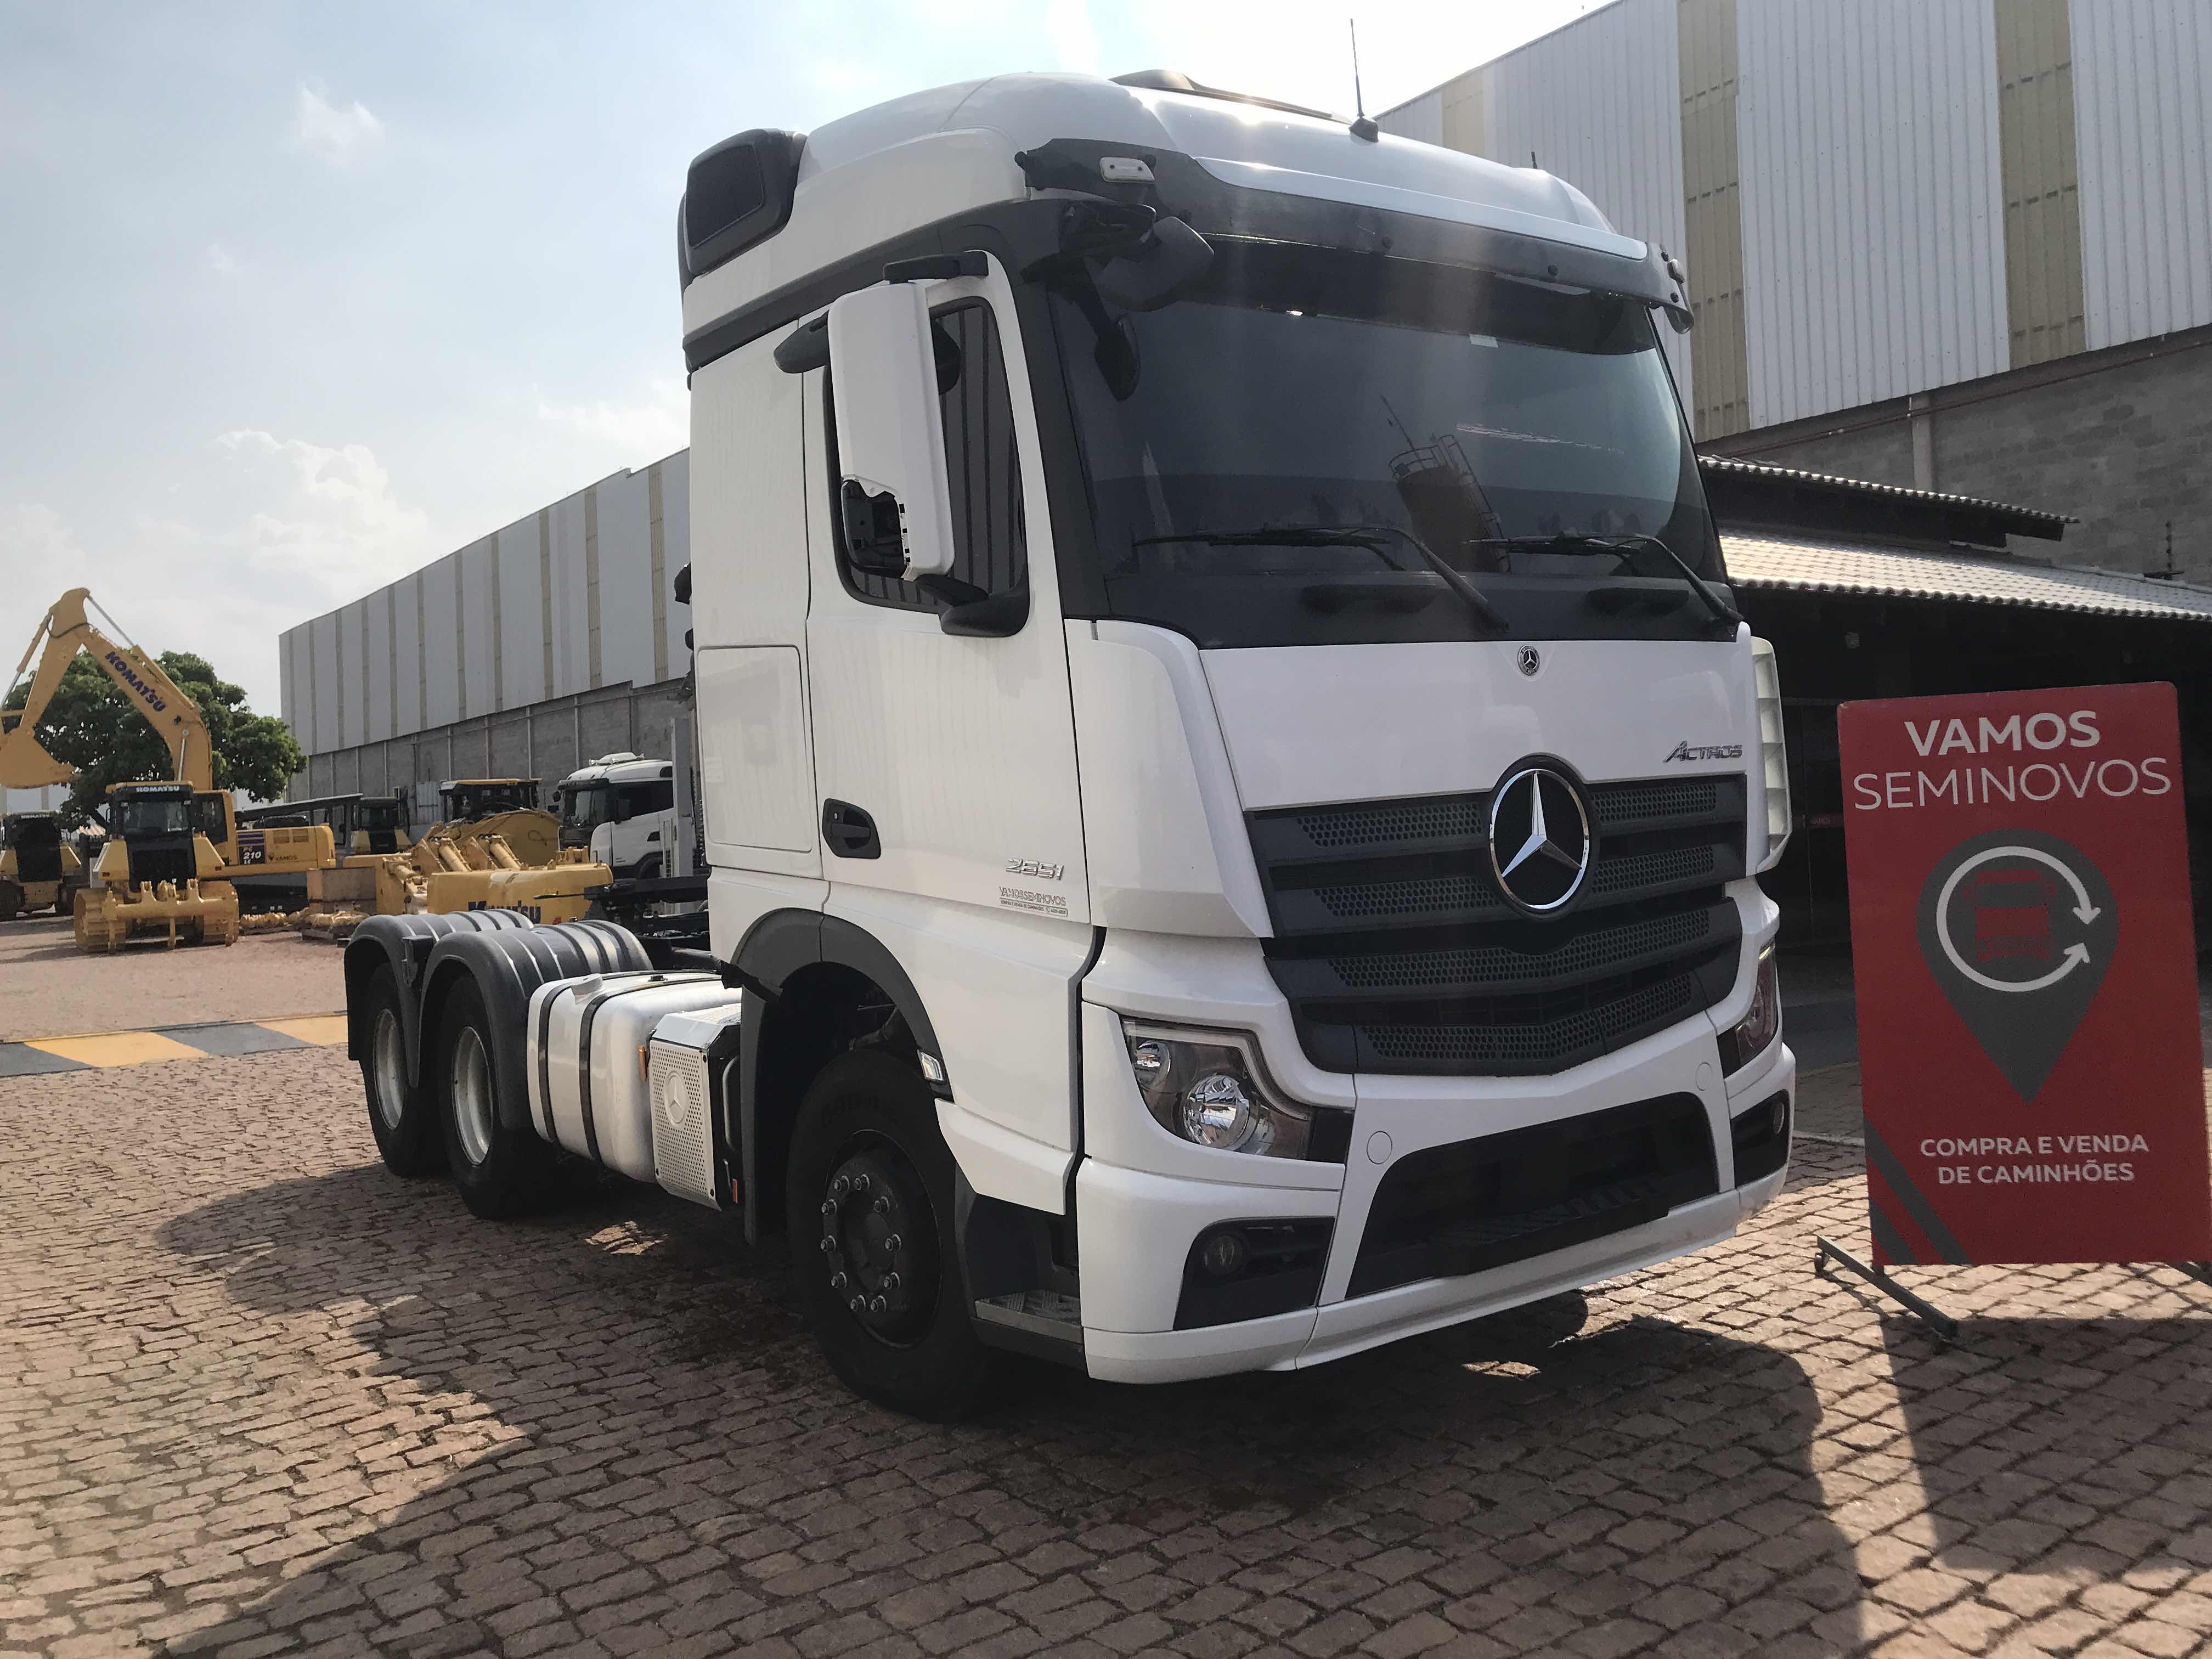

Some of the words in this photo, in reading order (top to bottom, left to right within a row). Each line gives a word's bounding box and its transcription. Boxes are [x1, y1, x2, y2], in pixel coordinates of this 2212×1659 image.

[105, 651, 166, 711] KOMATSU
[1904, 710, 2101, 757] VAMOS
[1853, 757, 2171, 810] SEMINOVOS
[243, 851, 262, 860] 210
[1920, 1137, 2033, 1156] COMPRA
[2037, 1136, 2053, 1154] E
[2057, 1133, 2150, 1153] VENDA
[1938, 1166, 1972, 1184] DE
[1977, 1159, 2135, 1184] CAMINHÕES
